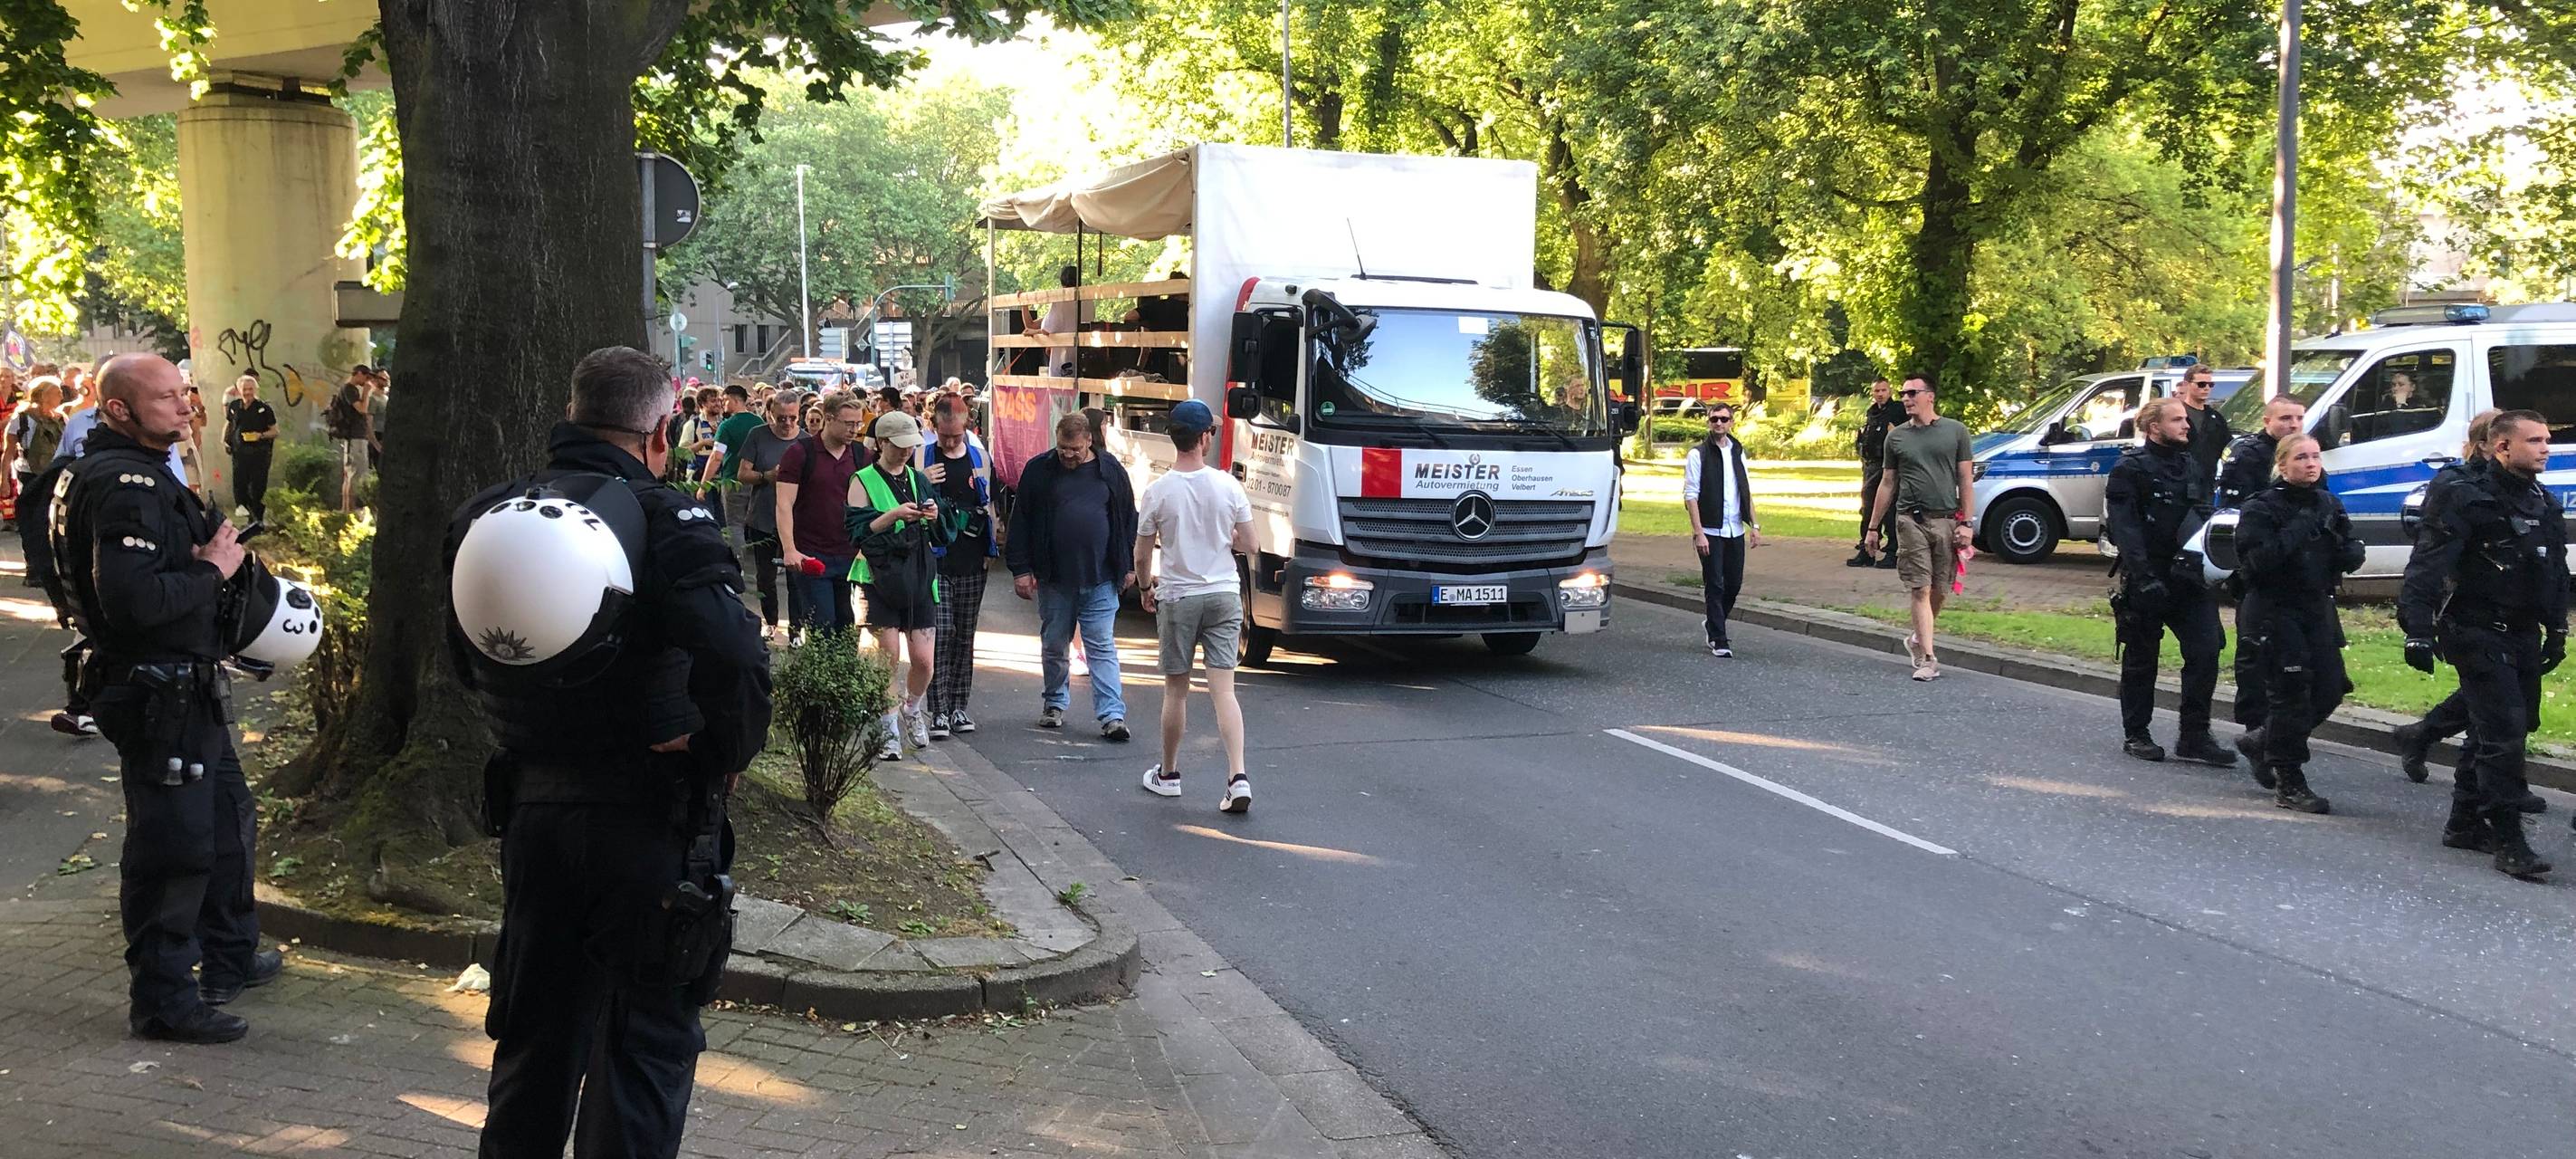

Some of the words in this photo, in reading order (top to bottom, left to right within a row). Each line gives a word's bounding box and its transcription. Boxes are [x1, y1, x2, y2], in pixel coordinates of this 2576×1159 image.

[997, 389, 1036, 424] BASS
[1251, 432, 1294, 455] MEISTER
[1415, 463, 1501, 480] MEISTER
[1512, 465, 1533, 474] Essen
[1246, 478, 1263, 491] 0201
[1267, 481, 1292, 497] 870087
[1416, 480, 1500, 492] Autovermietung
[1441, 589, 1448, 601] E
[1456, 589, 1473, 601] MA
[1475, 589, 1505, 600] 1511
